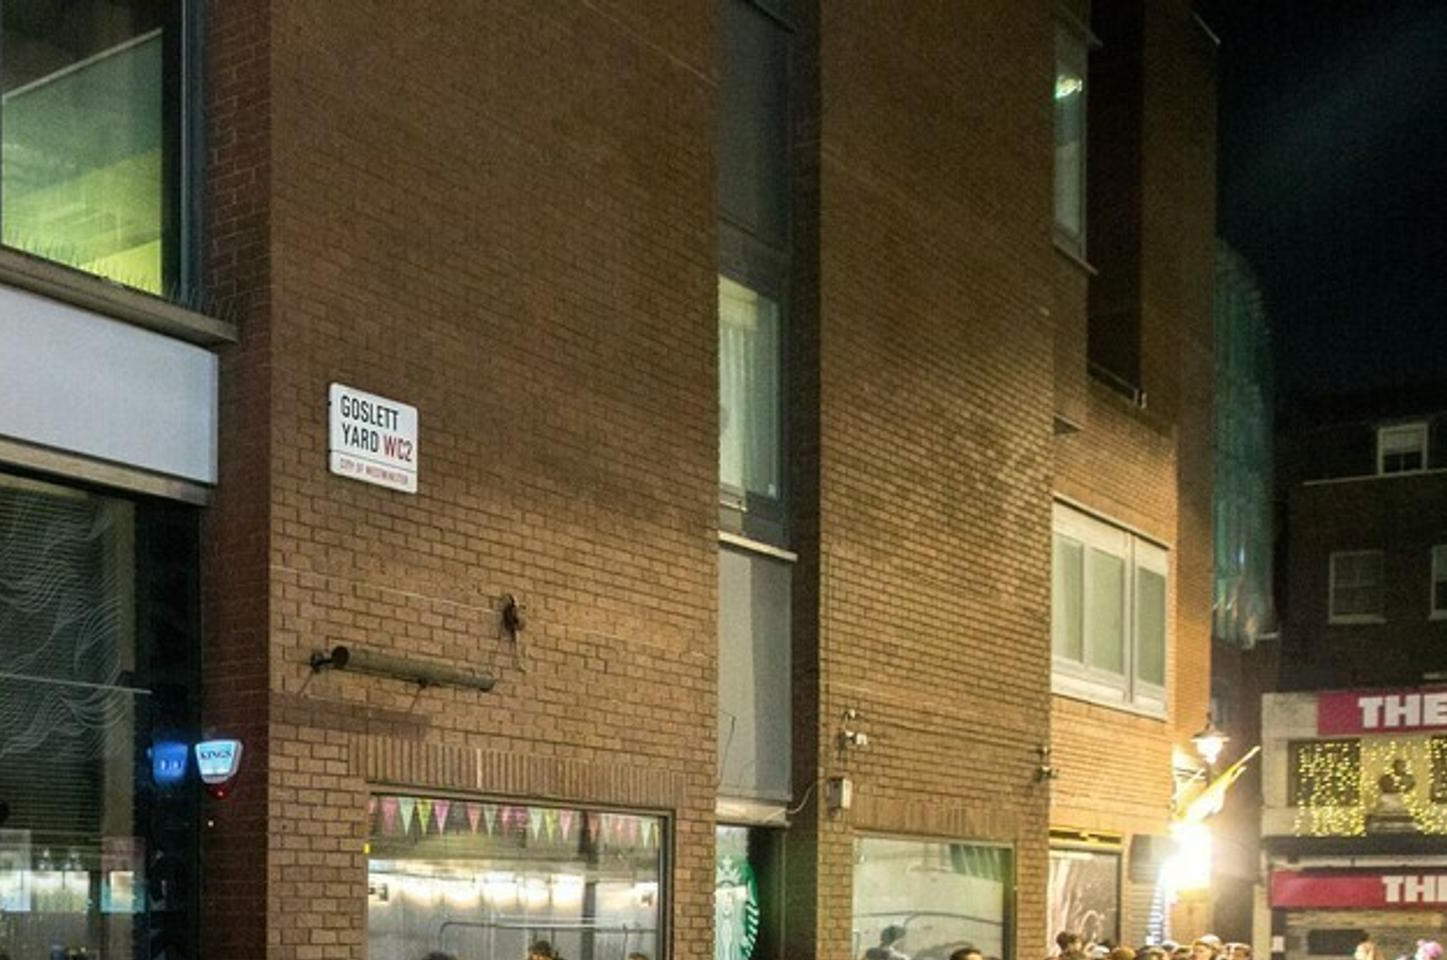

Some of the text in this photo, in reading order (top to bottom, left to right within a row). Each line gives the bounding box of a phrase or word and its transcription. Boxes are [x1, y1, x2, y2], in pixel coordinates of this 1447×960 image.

[340, 395, 399, 430] GOSLETT
[342, 423, 412, 462] YARD WC2
[1358, 693, 1447, 728] THE
